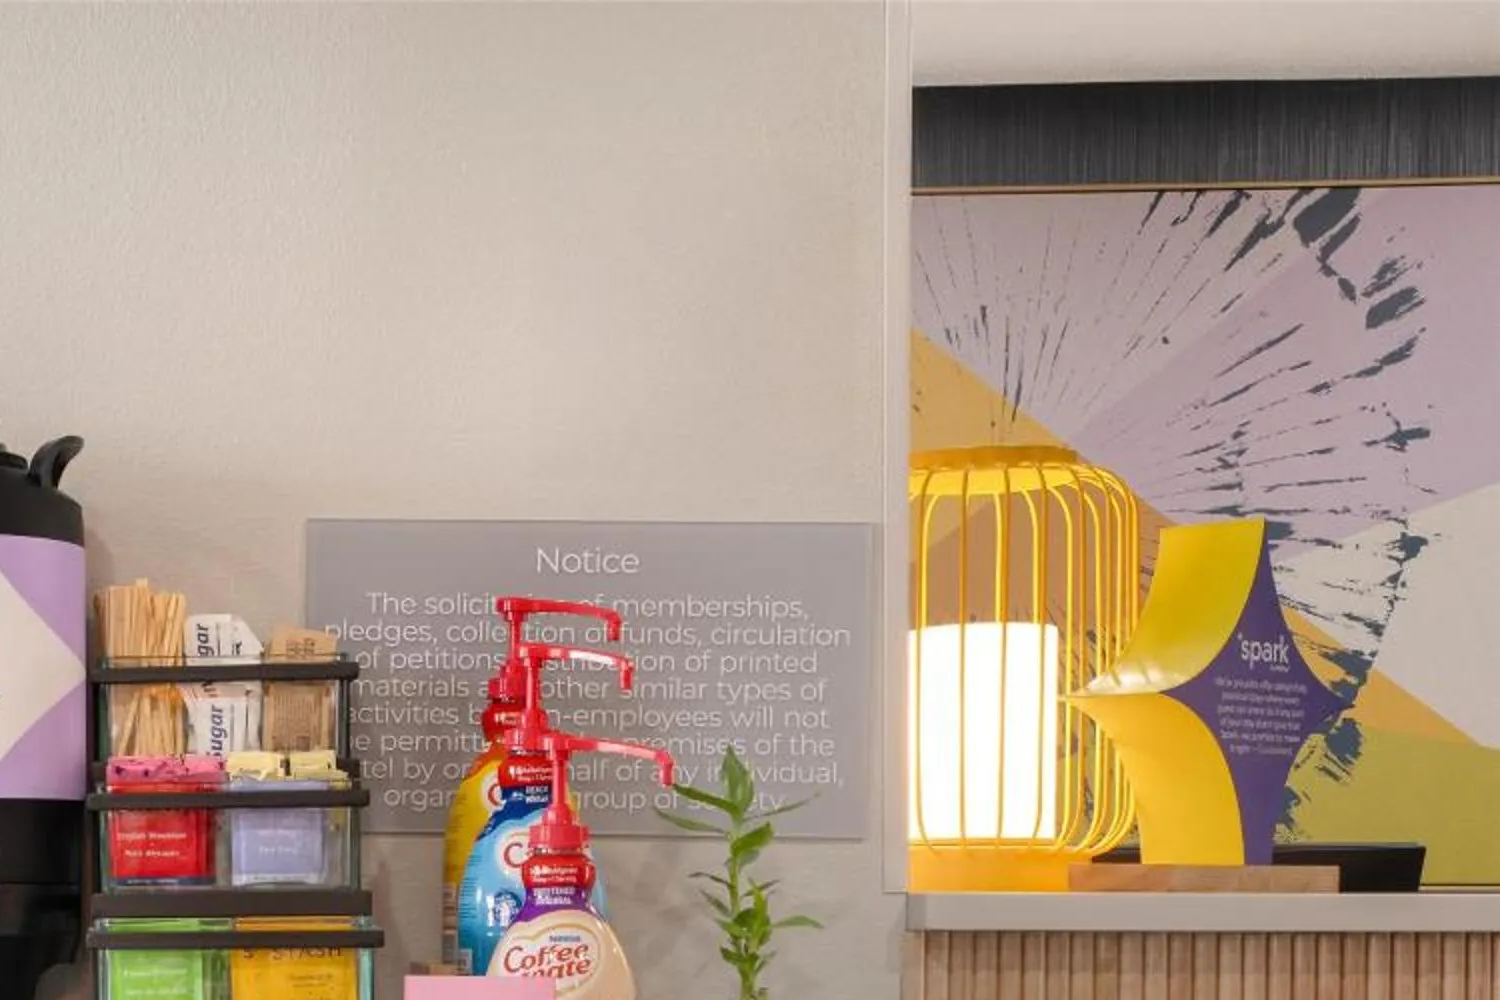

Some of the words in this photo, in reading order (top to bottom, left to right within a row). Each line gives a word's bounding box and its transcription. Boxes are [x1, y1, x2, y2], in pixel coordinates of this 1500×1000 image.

[536, 548, 640, 574] Notice
[366, 592, 417, 615] The
[424, 591, 566, 616] solicit
[612, 594, 810, 621] memberships,
[446, 621, 575, 644] colletion
[619, 622, 703, 648] funds,
[710, 622, 851, 646] circulation
[355, 648, 381, 670] of
[685, 650, 712, 672] of
[721, 651, 818, 676] printed
[1240, 635, 1290, 669] spark
[354, 675, 470, 698] materials
[541, 676, 610, 700] other
[717, 680, 792, 708] types
[801, 677, 828, 701] of
[350, 700, 459, 725] activities
[547, 704, 723, 733] n-employees
[731, 705, 774, 728] will
[785, 709, 831, 729] not
[380, 729, 492, 756] permitt
[755, 733, 783, 756] of
[790, 734, 835, 757] the
[360, 757, 394, 779] tel
[404, 758, 437, 785] by
[616, 759, 643, 782] of
[707, 762, 844, 788] inividual,
[503, 943, 590, 974] Coffee
